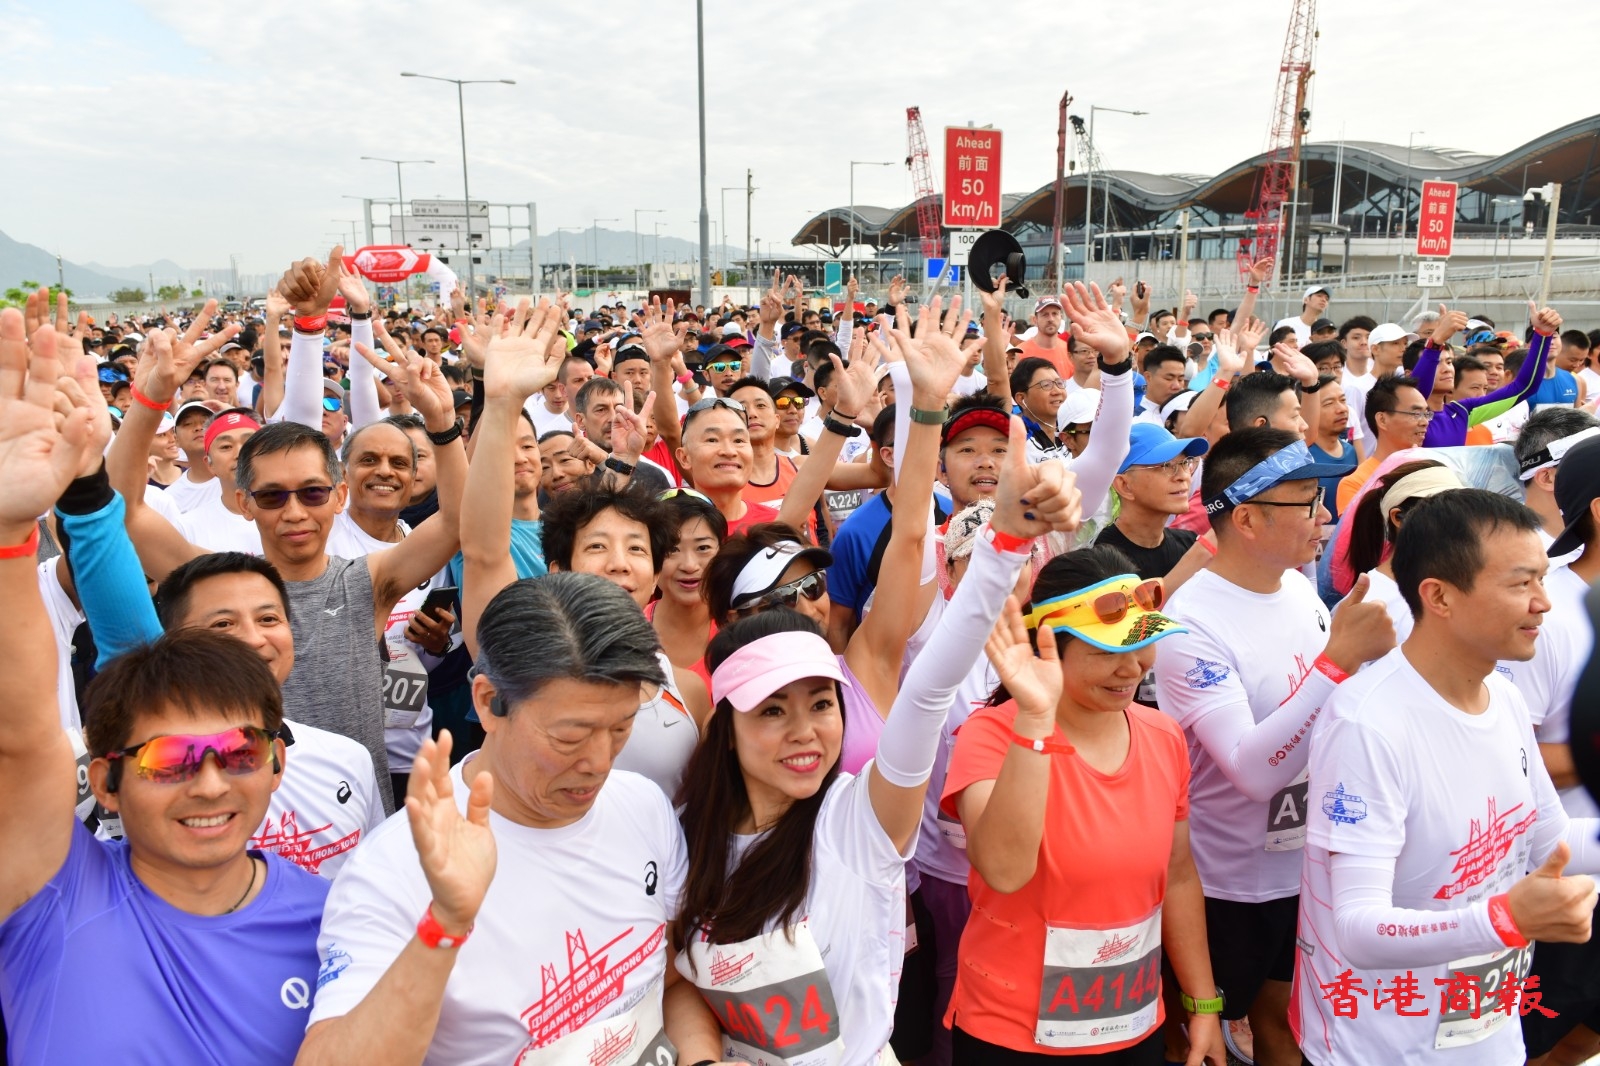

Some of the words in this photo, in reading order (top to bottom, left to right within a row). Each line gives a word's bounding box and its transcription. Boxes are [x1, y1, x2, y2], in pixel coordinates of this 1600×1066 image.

[955, 135, 992, 150] Ahead
[958, 154, 989, 172] 前面
[961, 178, 985, 196] 50
[1428, 187, 1451, 198] Ahead
[951, 199, 993, 221] km/h
[1428, 202, 1448, 215] 前面
[1428, 219, 1444, 233] 50
[958, 235, 975, 244] 100
[1421, 235, 1448, 252] km/h
[1047, 956, 1157, 1014] A4144
[541, 1005, 572, 1035] BANK
[571, 998, 585, 1014] OF
